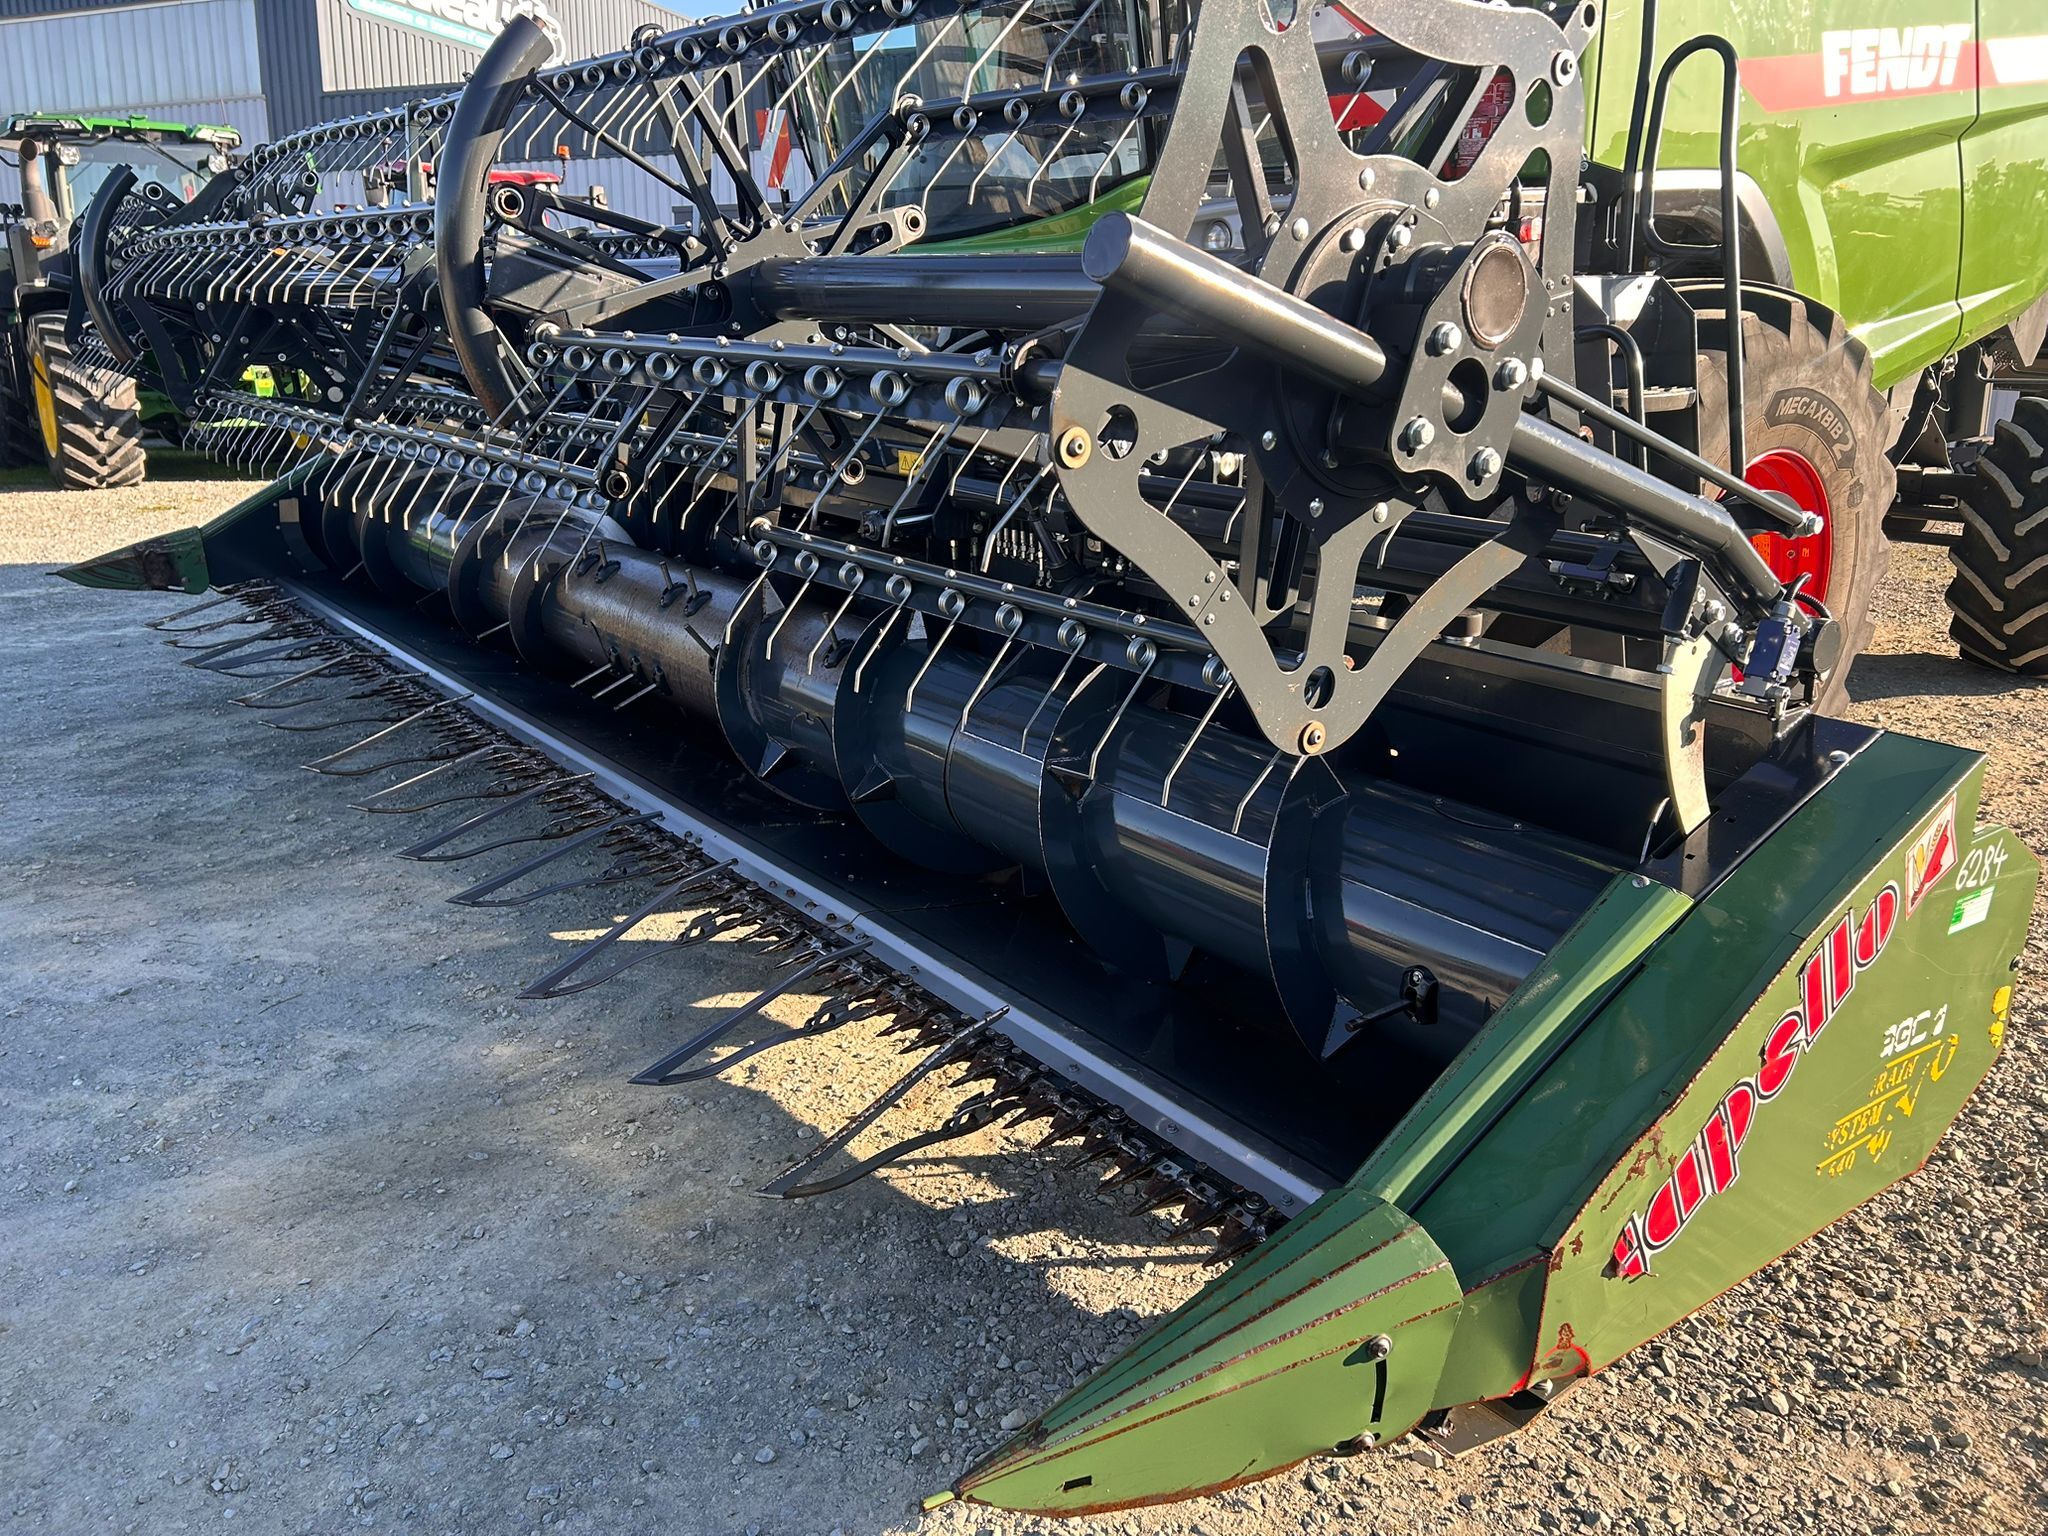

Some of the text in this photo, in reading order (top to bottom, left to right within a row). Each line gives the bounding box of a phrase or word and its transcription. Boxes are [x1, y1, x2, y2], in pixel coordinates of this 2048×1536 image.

[1821, 23, 1973, 98] FENDT
[1775, 395, 1854, 461] MEGAXBIB 2
[1954, 836, 2009, 892] 6284
